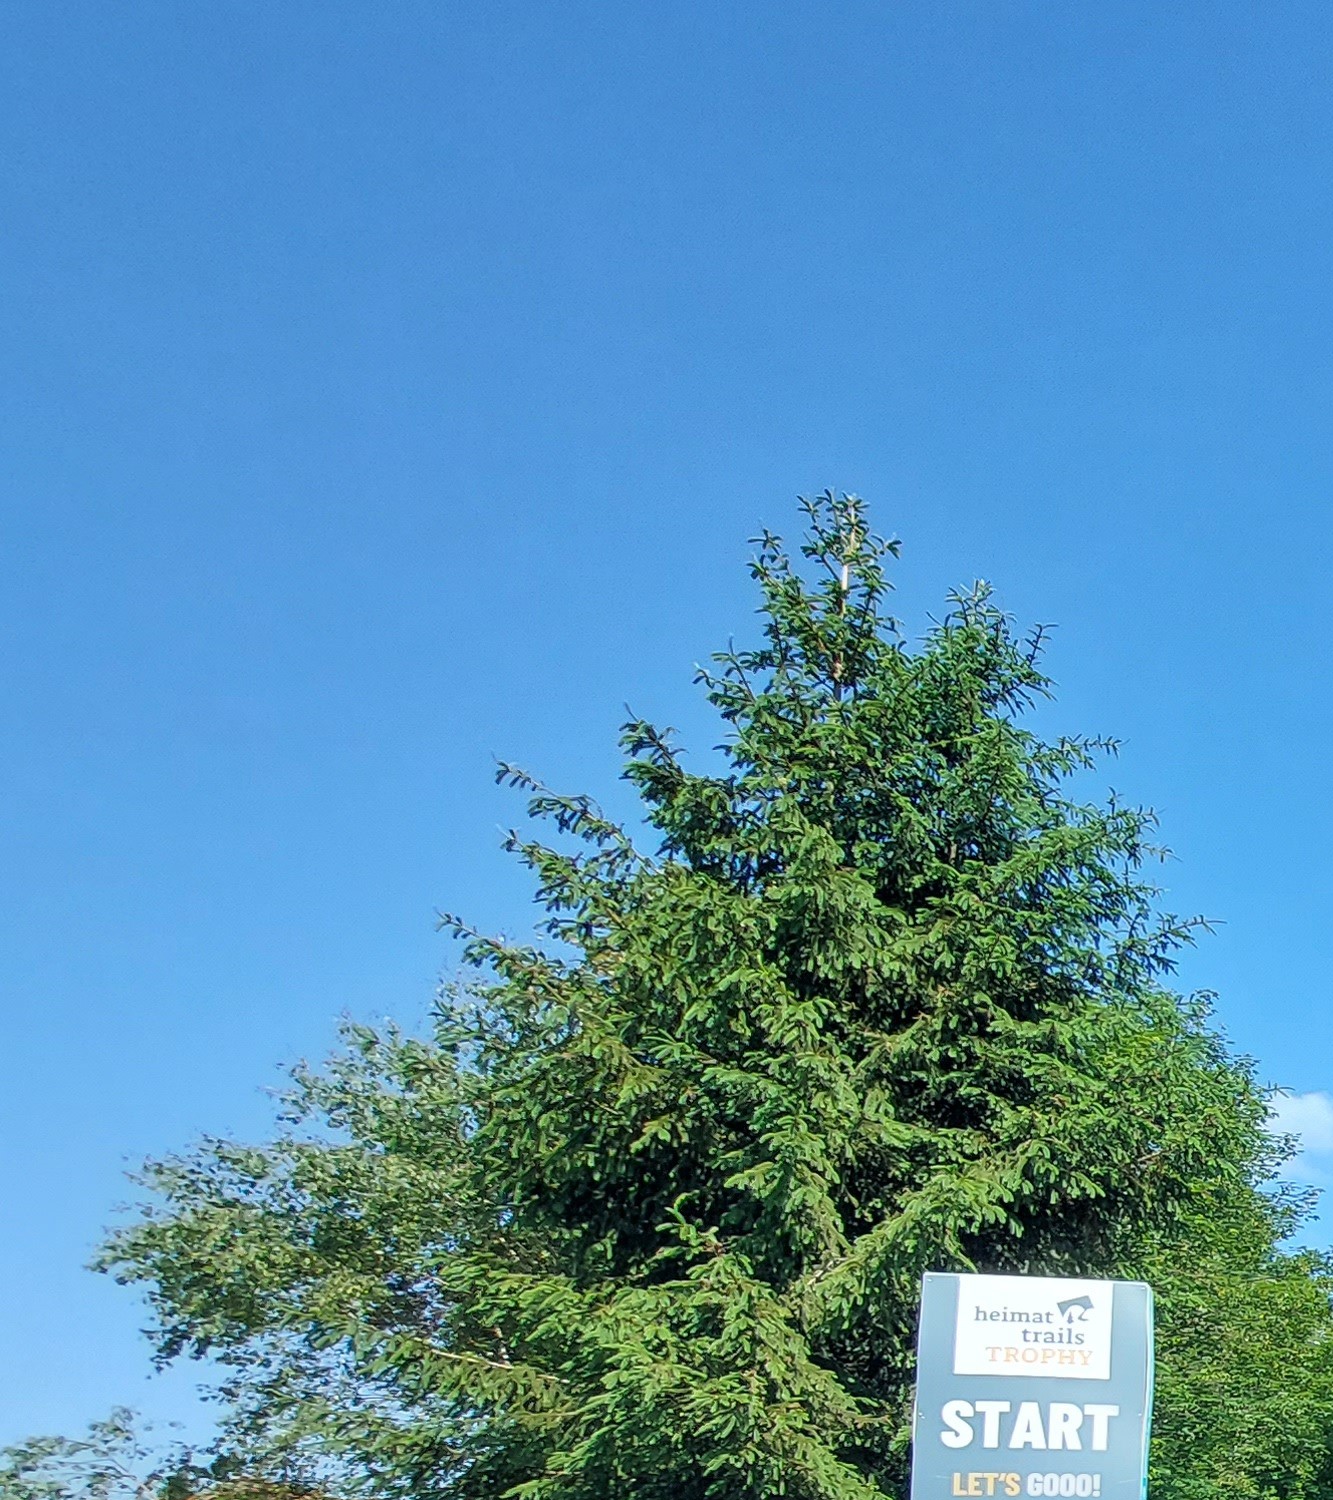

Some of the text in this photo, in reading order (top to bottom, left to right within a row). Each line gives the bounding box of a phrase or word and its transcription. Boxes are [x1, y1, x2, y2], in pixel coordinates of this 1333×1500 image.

[974, 1306, 1054, 1324] heimat
[1022, 1328, 1085, 1345] trails
[986, 1346, 1093, 1366] TROPHY
[941, 1399, 1120, 1450] START
[953, 1472, 1101, 1497] LET'S GOOO!
